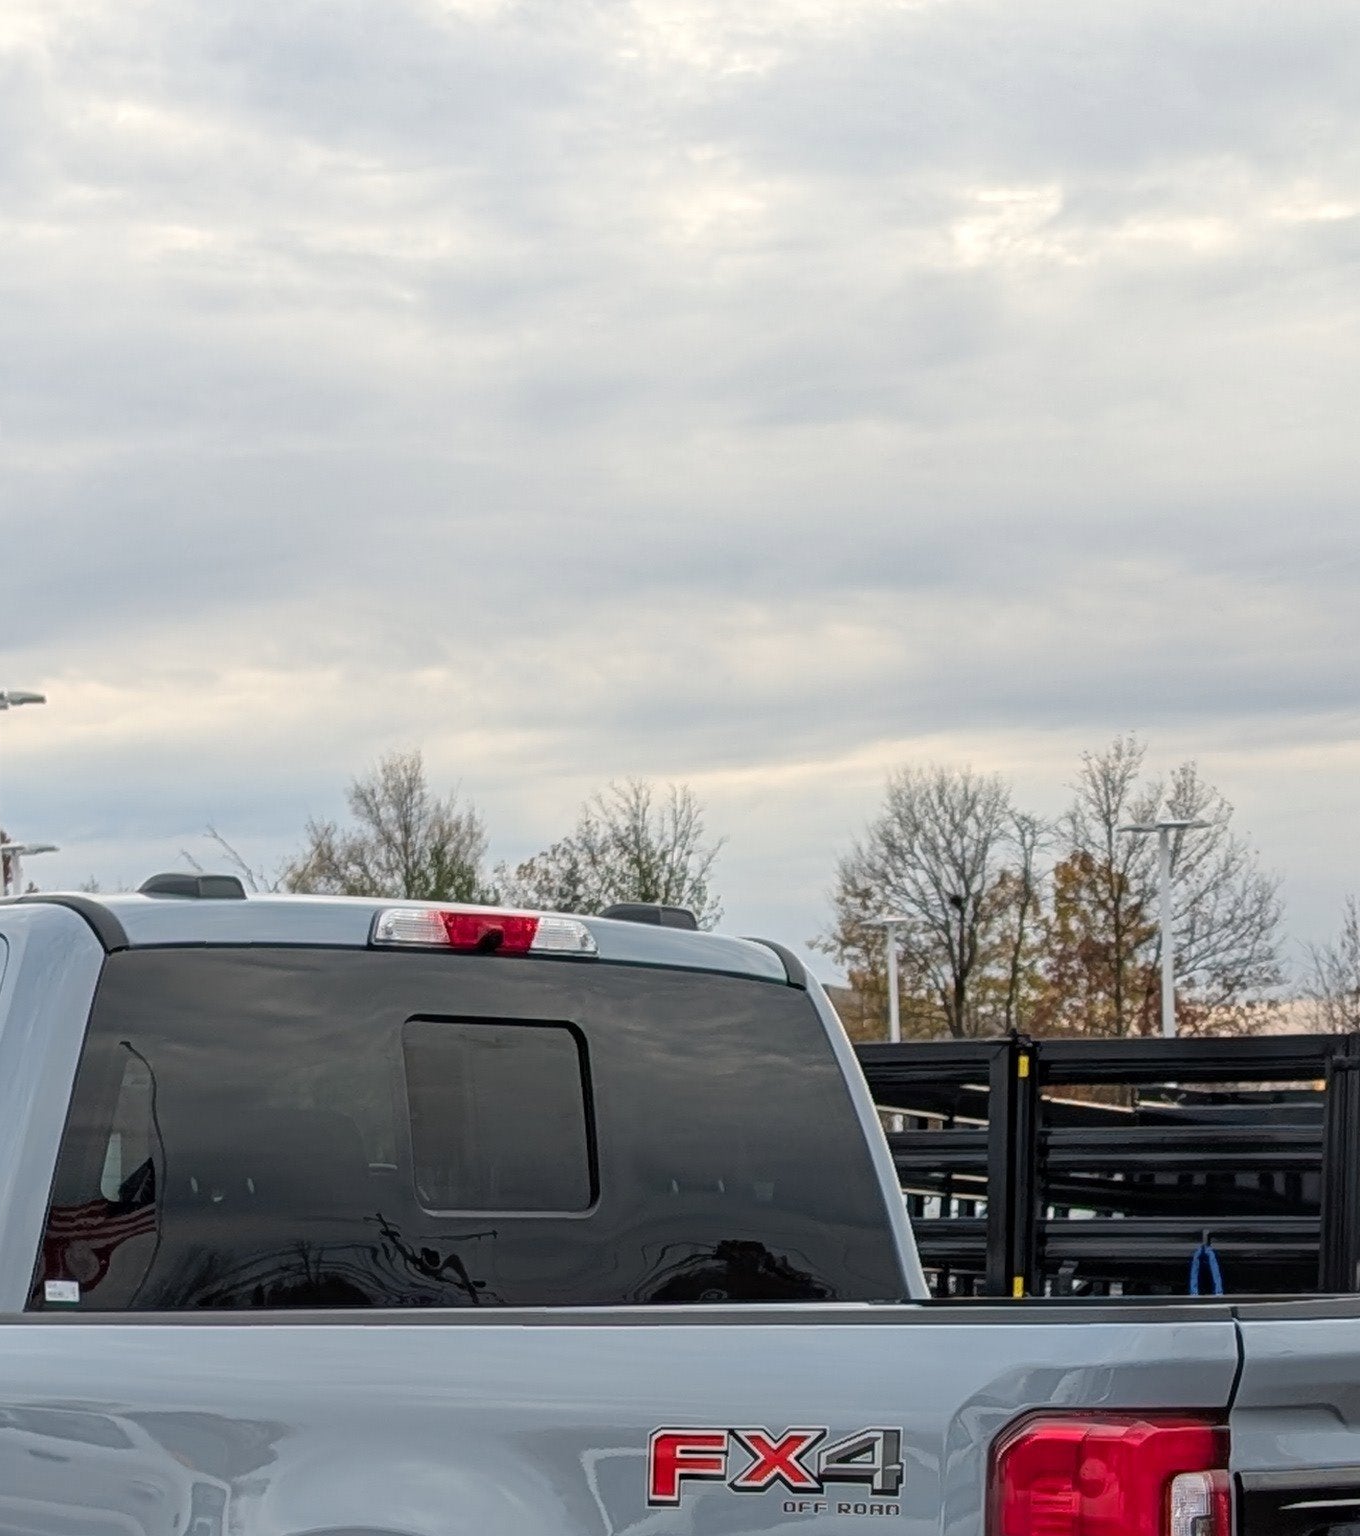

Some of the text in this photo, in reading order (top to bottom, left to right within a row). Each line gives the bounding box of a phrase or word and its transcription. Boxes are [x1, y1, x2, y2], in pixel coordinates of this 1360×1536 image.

[646, 1426, 905, 1508] FX4
[782, 1500, 900, 1516] OFF ROAD
